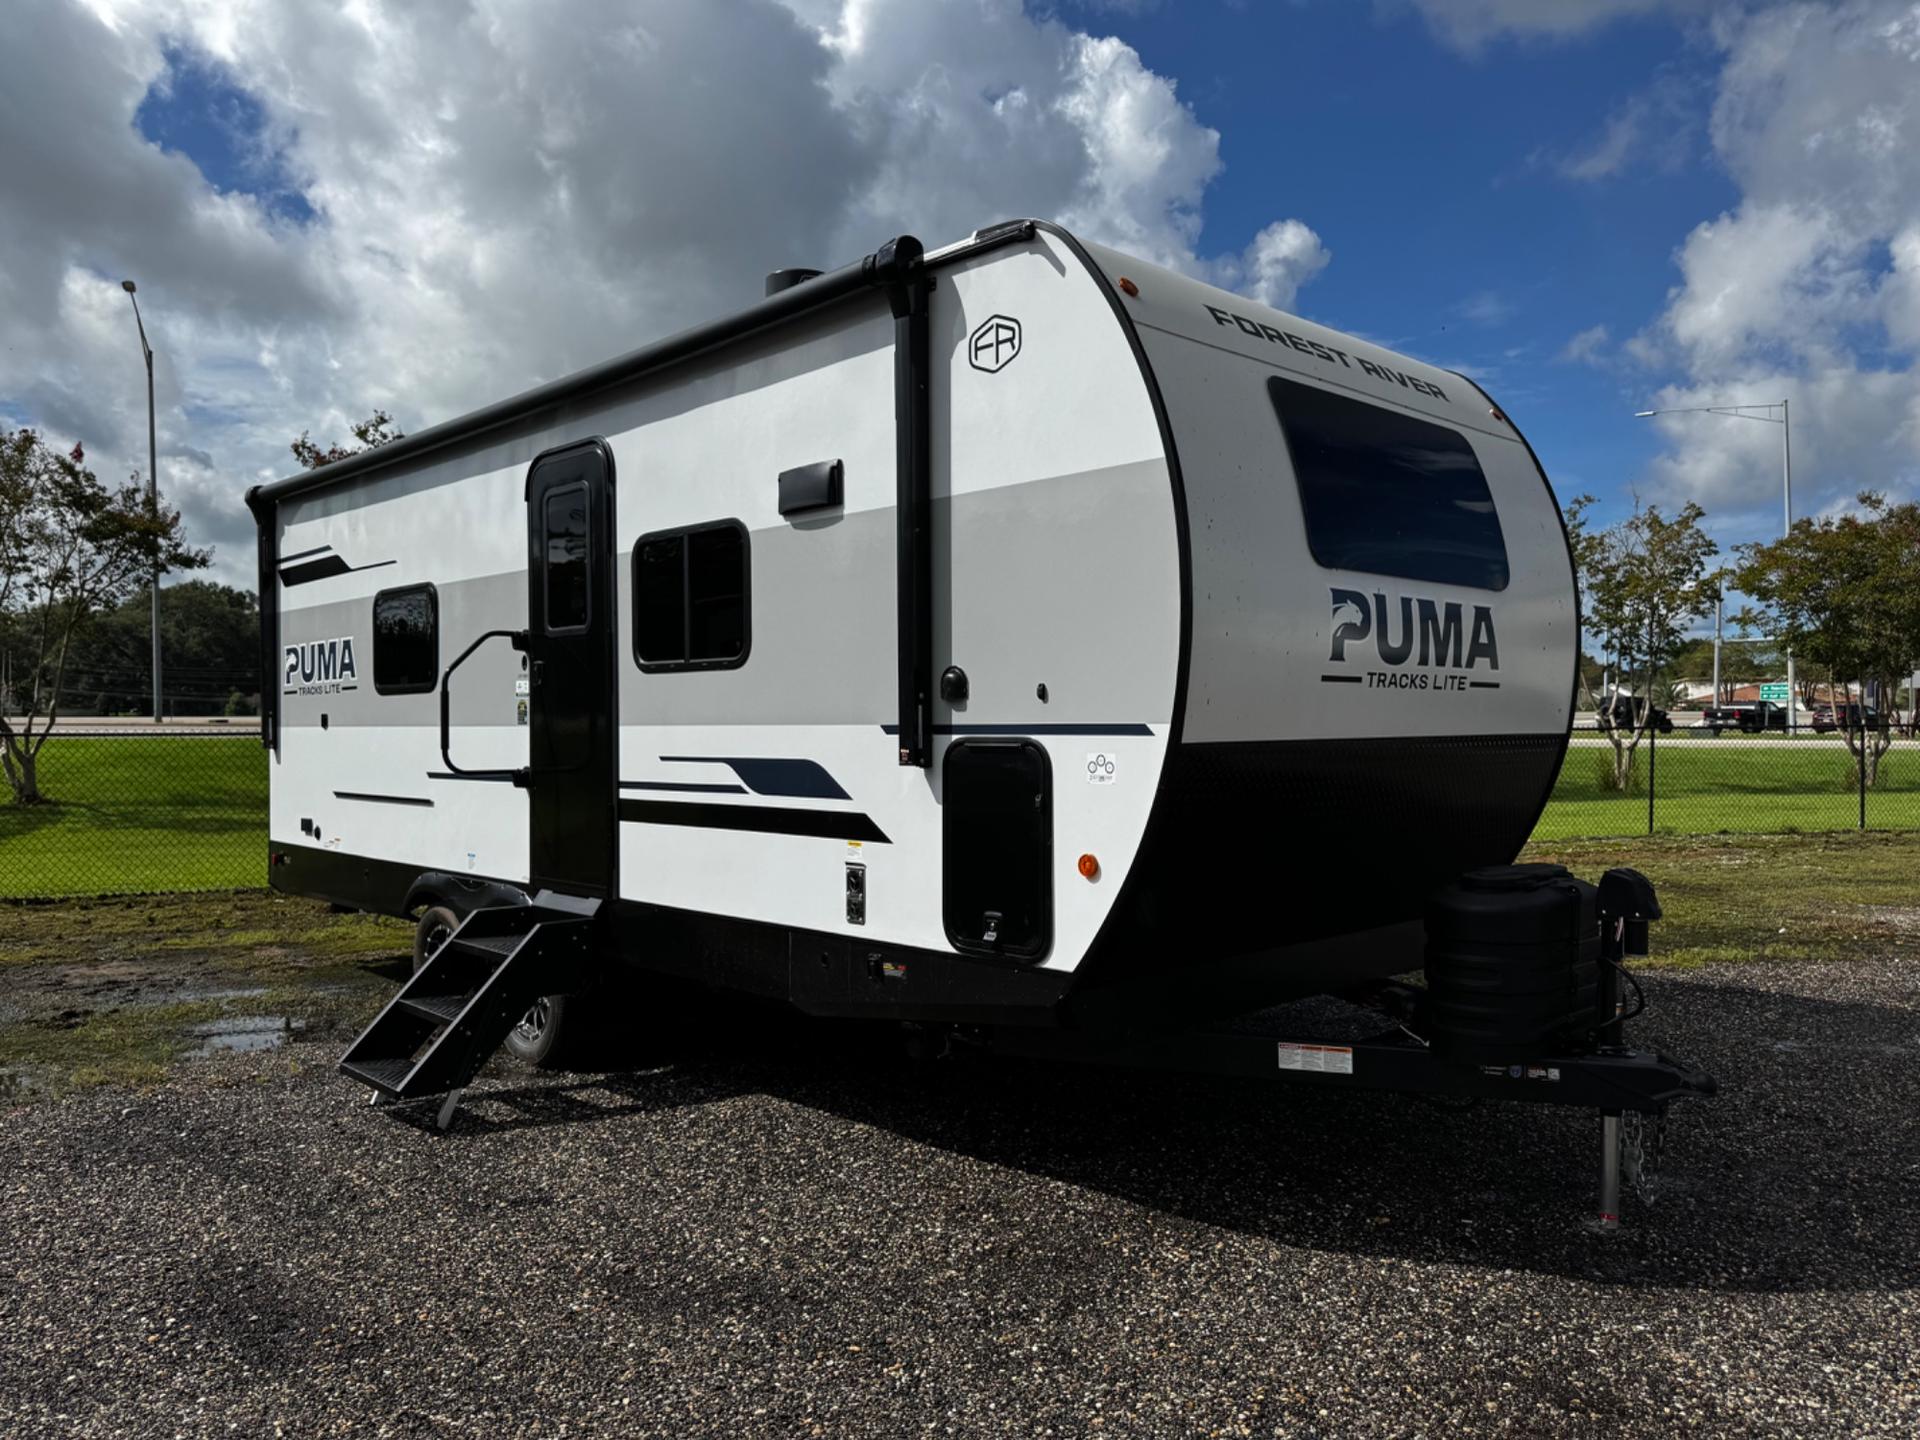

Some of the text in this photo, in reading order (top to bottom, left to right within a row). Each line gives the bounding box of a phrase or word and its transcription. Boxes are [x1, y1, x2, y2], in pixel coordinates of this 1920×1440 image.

[1203, 304, 1450, 402] FOREST RIVER
[1329, 587, 1500, 671] PUMA
[285, 639, 356, 685] PUMA
[1366, 671, 1468, 691] TRACKS LITE
[298, 684, 341, 696] TRACKS LITE
